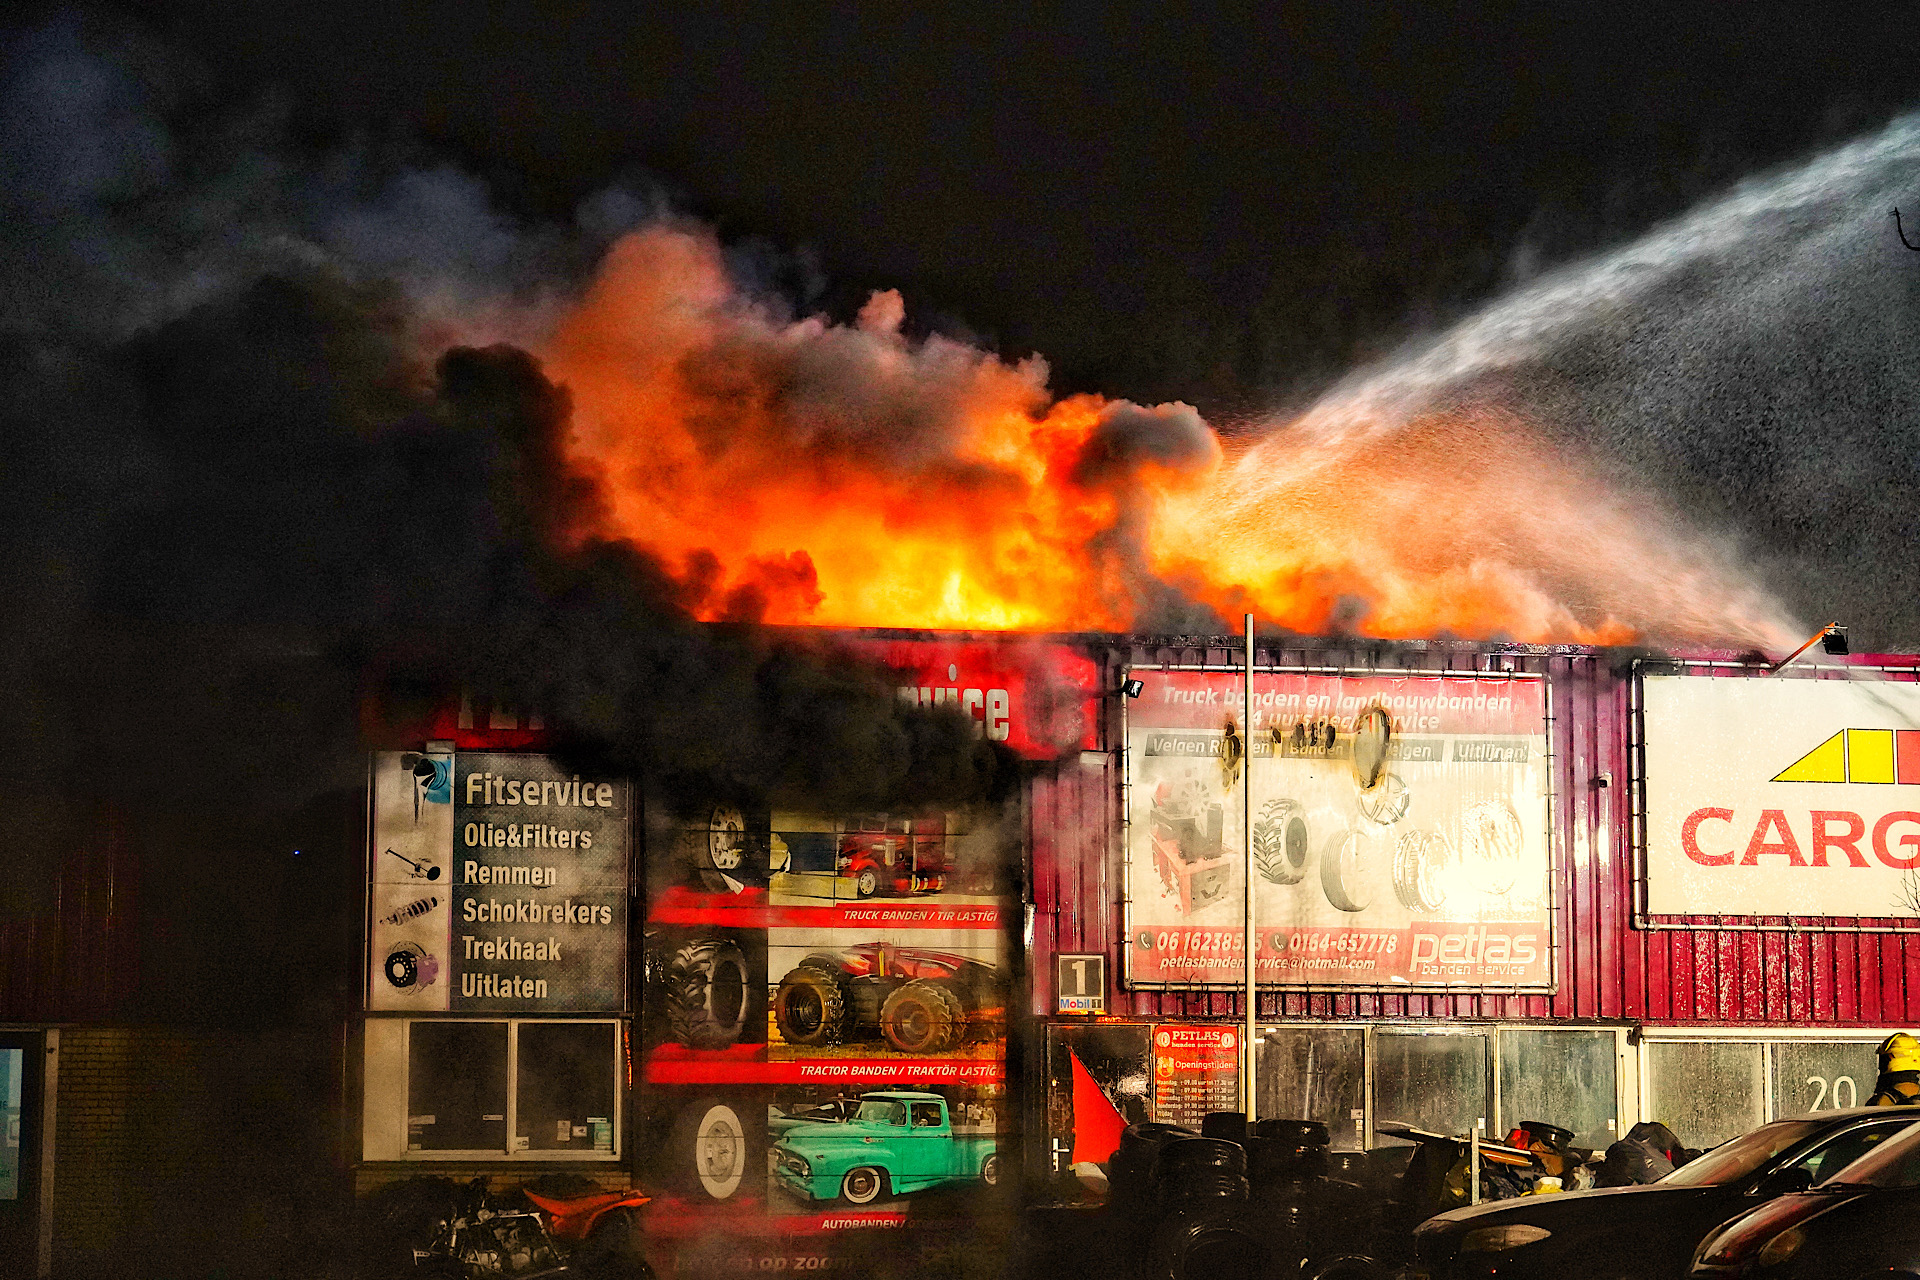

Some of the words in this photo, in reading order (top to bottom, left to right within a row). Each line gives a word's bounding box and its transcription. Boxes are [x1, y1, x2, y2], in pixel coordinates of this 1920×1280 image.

[1162, 686, 1218, 704] Truck
[1306, 694, 1331, 708] en
[1336, 692, 1512, 711] landbouwbanden
[1237, 708, 1262, 726] 24
[1153, 738, 1205, 754] Velgen
[466, 772, 613, 808] Fitservice
[464, 823, 592, 849] Olie&Filters
[1681, 806, 1920, 870] CARG
[464, 860, 557, 885] Remmen
[463, 898, 612, 925] Schokbrekers
[844, 910, 880, 920] TRUCK
[881, 910, 927, 921] BANDEN
[937, 911, 955, 921] TIR
[462, 935, 562, 961] Trekhaak
[1156, 932, 1179, 951] 06
[1184, 932, 1264, 951] 1623855
[1289, 933, 1398, 953] 0164-657778
[1409, 925, 1536, 972] petlas
[1160, 955, 1376, 970] petlasbandenervice@hotmail.com
[1421, 963, 1471, 975] banden
[1476, 963, 1525, 975] service
[461, 973, 548, 998] Uitlaten
[1072, 960, 1086, 995] 1
[1060, 999, 1090, 1008] Mobil
[1172, 1031, 1220, 1041] PETLAS
[800, 1066, 848, 1076] TRACTOR
[850, 1066, 897, 1076] BANDEN
[907, 1065, 957, 1076] TRAKTÖR
[1175, 1060, 1234, 1070] Openingstijden
[1806, 1075, 1857, 1114] 20
[822, 1219, 898, 1230] AUTOBANDEN
